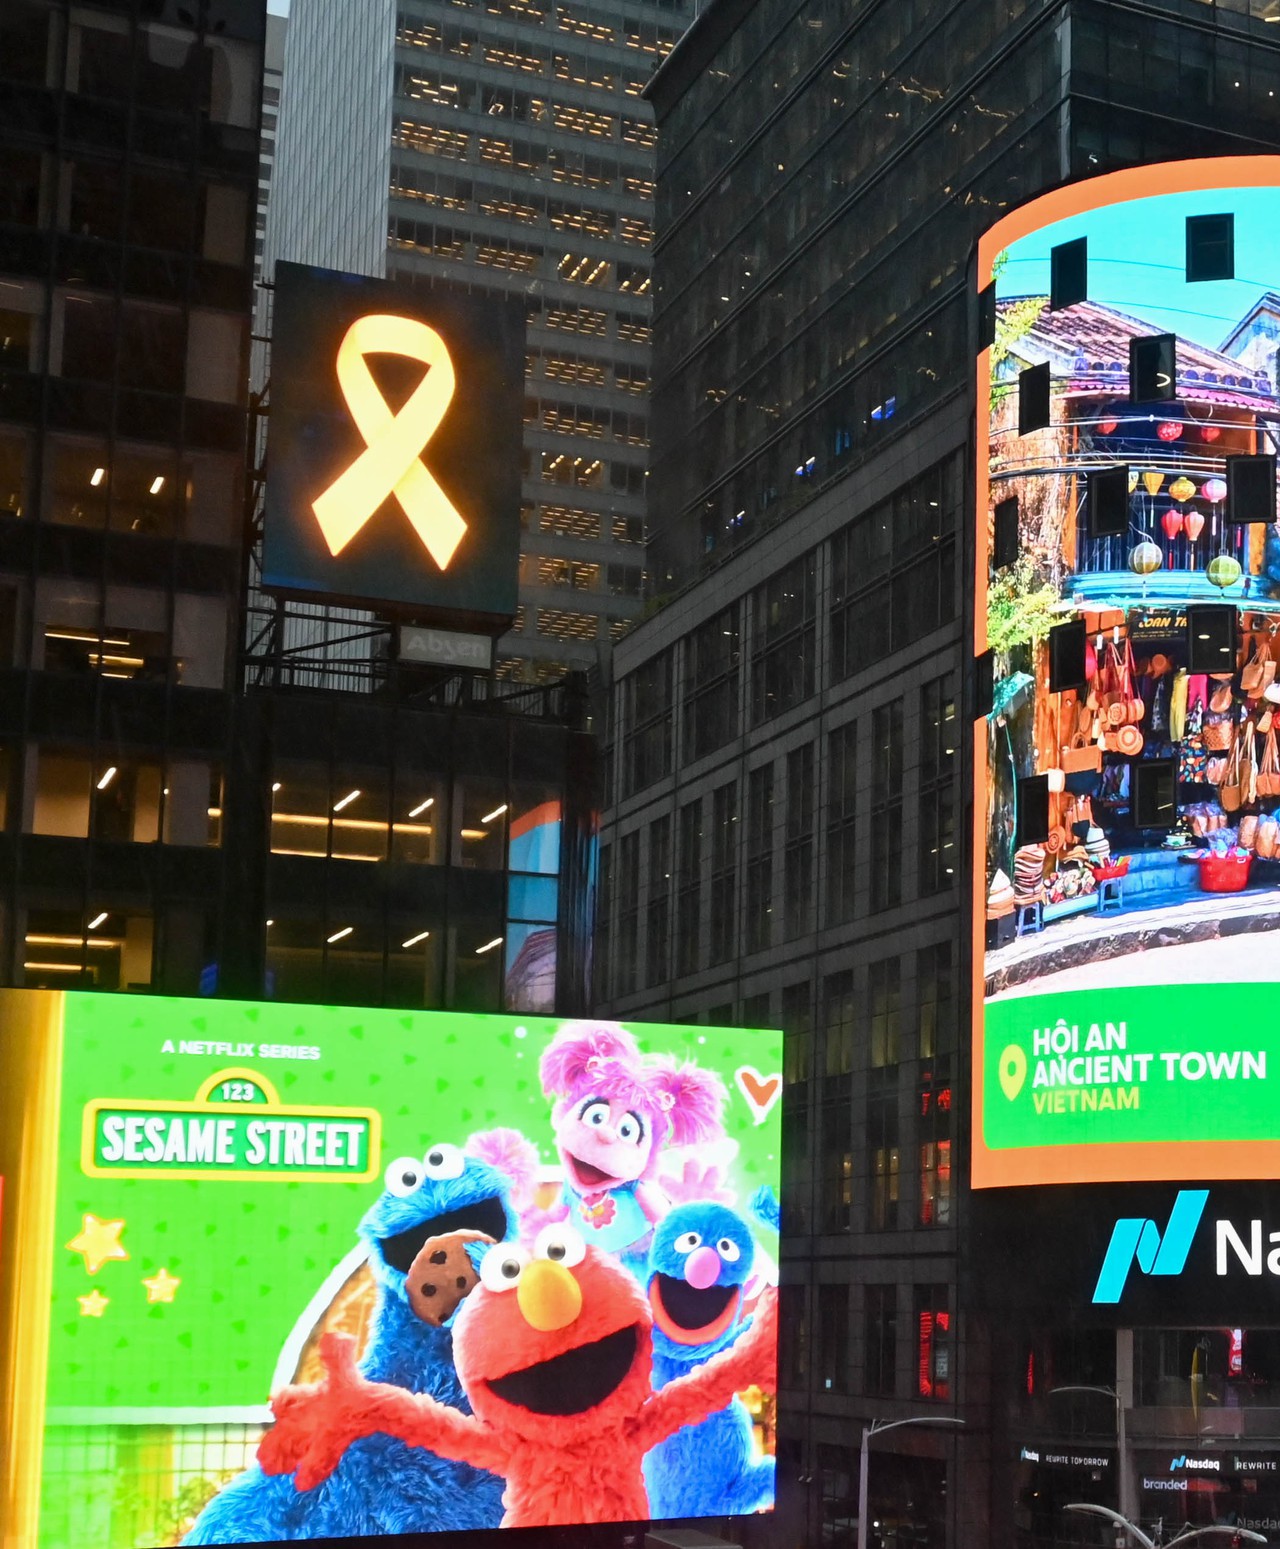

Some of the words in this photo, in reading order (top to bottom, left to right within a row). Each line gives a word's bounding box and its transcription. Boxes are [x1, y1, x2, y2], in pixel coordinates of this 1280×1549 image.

[407, 631, 485, 660] Absen
[161, 1040, 175, 1054] A
[178, 1041, 254, 1057] NETFLIX
[258, 1044, 321, 1060] SERIES
[1084, 1021, 1127, 1052] AN
[1032, 1053, 1154, 1088] ANCIENT
[1160, 1051, 1267, 1081] TOWN
[222, 1083, 254, 1101] 123
[1032, 1087, 1140, 1115] VIETNAM
[101, 1116, 236, 1164] SESAME
[245, 1121, 365, 1167] STREET
[1185, 1459, 1220, 1471] Nasdaq
[1236, 1462, 1277, 1470] REWRITE
[1143, 1478, 1188, 1491] branded
